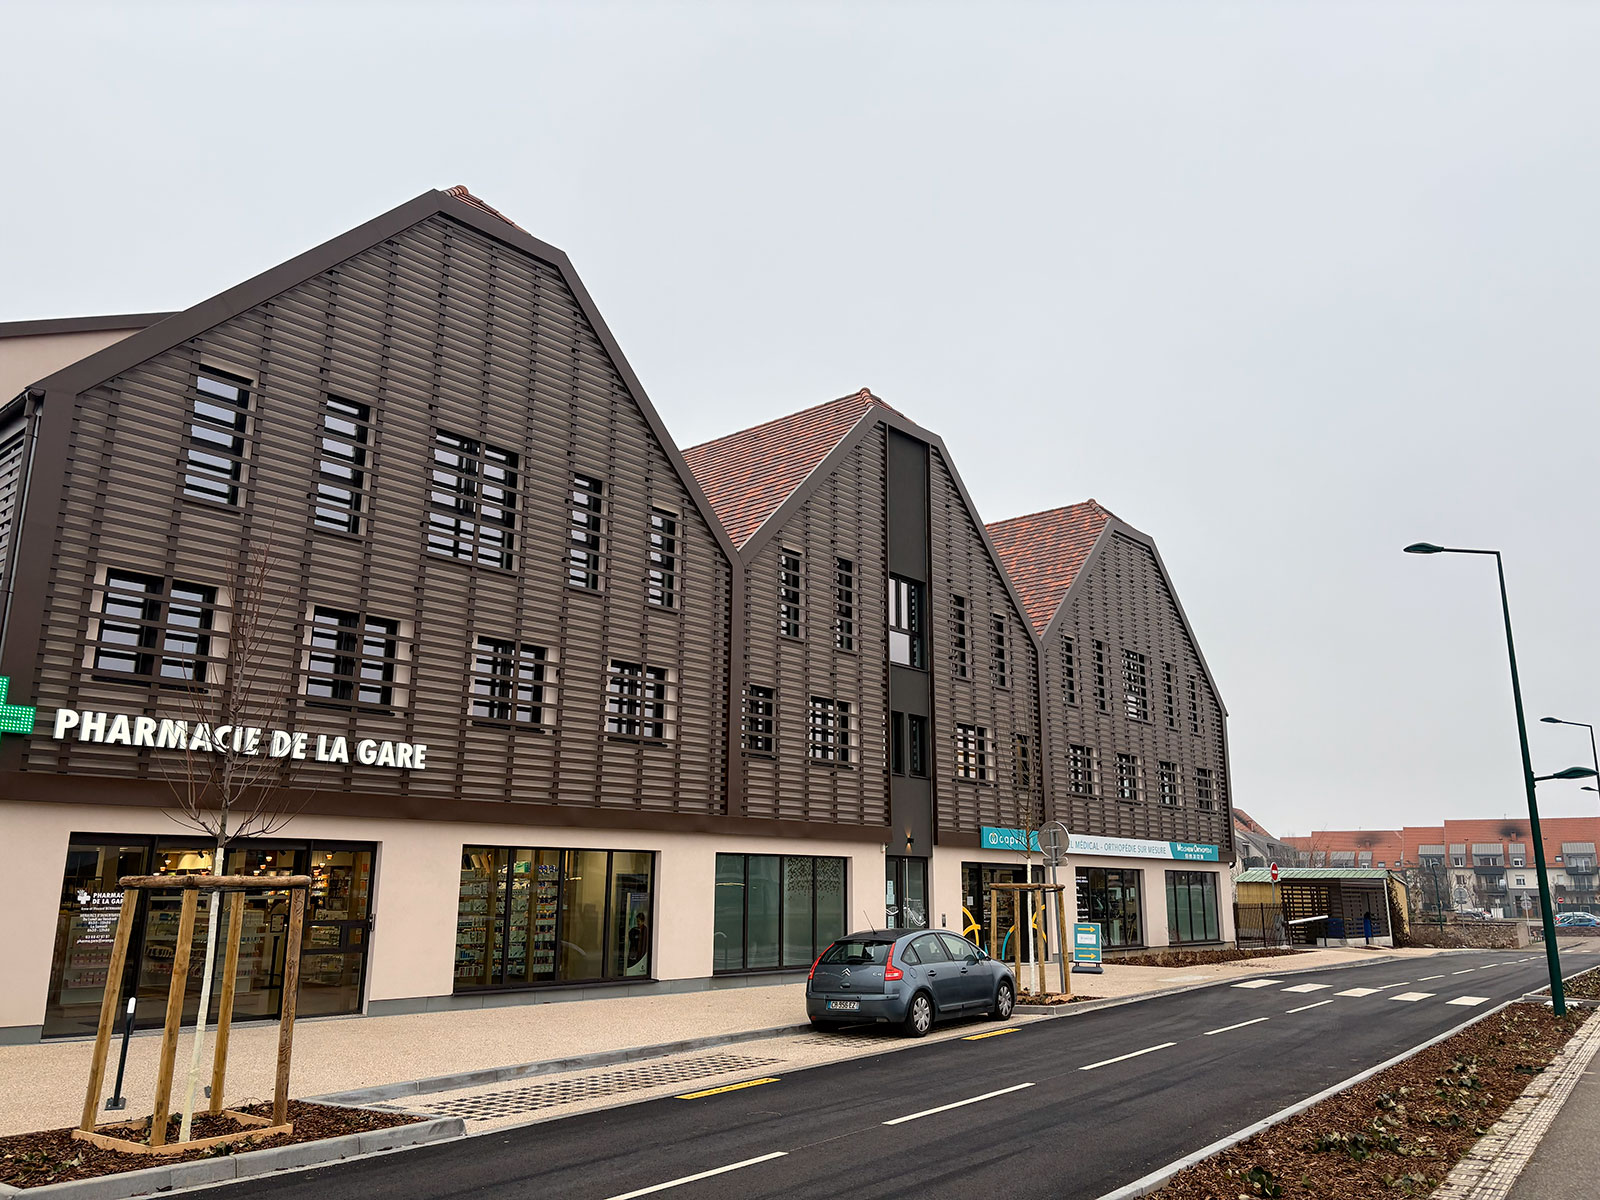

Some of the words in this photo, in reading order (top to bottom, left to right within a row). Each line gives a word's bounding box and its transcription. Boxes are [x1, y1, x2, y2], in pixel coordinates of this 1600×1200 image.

[52, 708, 262, 756] PHARMACIE
[269, 730, 309, 760] DE
[315, 734, 350, 764] LA
[356, 738, 428, 770] GARE
[1075, 836, 1100, 850] MÉDICAL
[1104, 842, 1137, 853] ORTHOPÉDIE
[1137, 845, 1149, 854] SUR
[1149, 845, 1167, 855] MESURE
